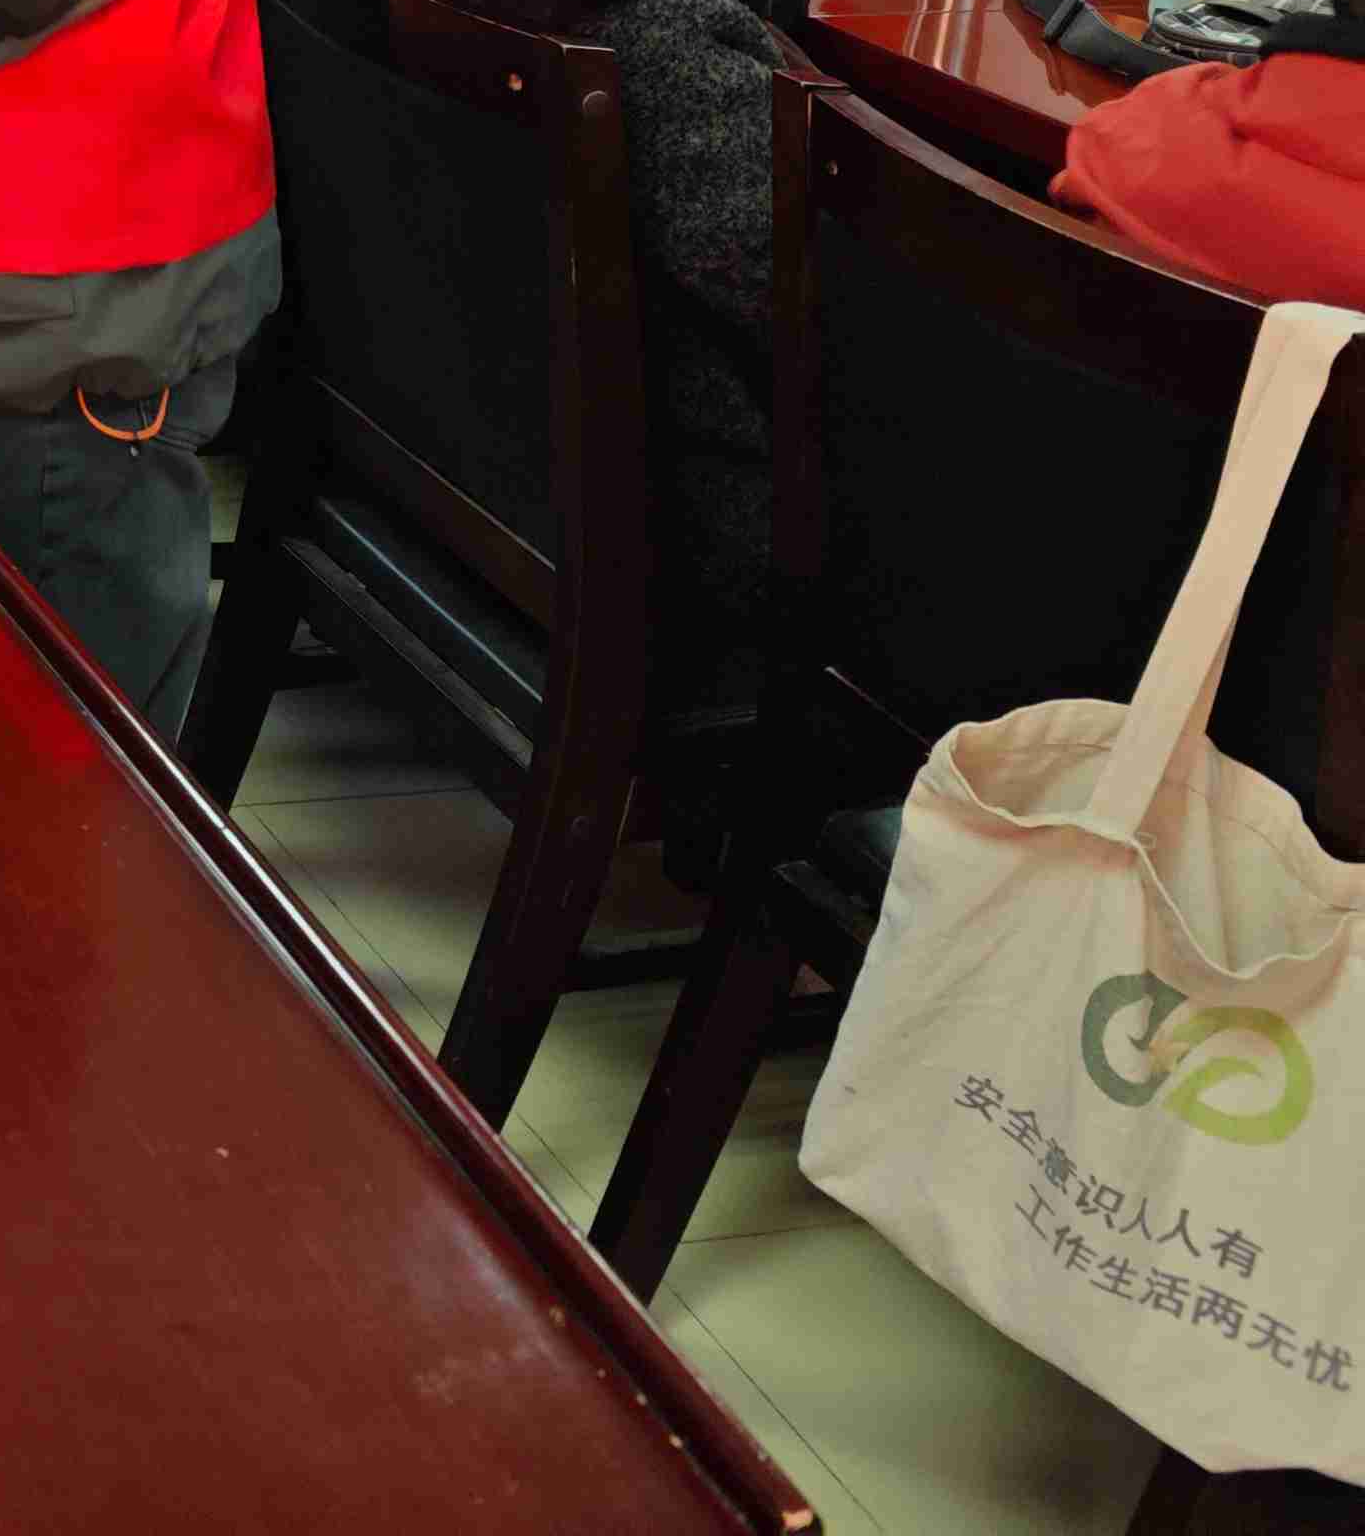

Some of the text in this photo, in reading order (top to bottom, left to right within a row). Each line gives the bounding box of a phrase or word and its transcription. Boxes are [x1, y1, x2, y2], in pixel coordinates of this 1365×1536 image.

[954, 1074, 1264, 1280] 安全意识人人有
[1014, 1183, 1354, 1393] 工作生活两无忧
